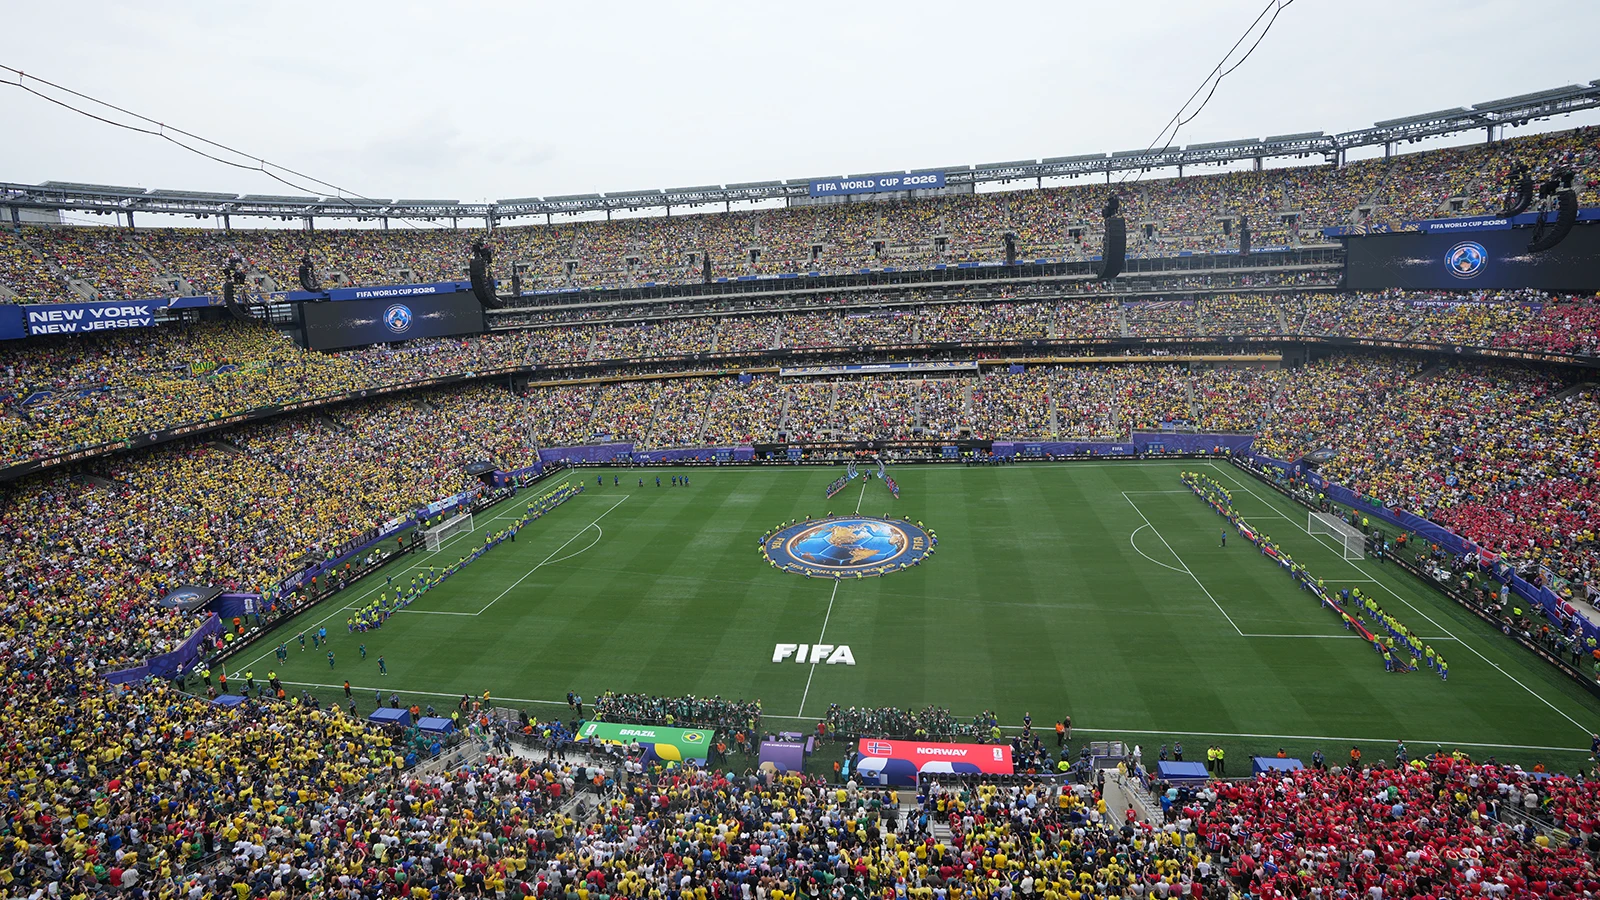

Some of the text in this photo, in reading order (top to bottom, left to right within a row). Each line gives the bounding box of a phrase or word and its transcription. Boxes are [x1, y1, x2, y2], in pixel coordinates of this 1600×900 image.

[816, 175, 937, 191] FIFA WORLD CUP 2026
[1444, 221, 1468, 229] WORLD
[372, 289, 398, 297] WORLD
[29, 305, 150, 323] NEW YORK
[31, 317, 151, 335] NEW JERSEY
[1542, 355, 1575, 363] JERSEY
[41, 441, 126, 468] NEW YORK NEW JERS
[771, 537, 786, 550] FIFA
[912, 536, 923, 551] FIFA
[772, 643, 856, 665] FIFA
[619, 728, 656, 738] BRAZIL
[916, 746, 968, 757] NORWAY
